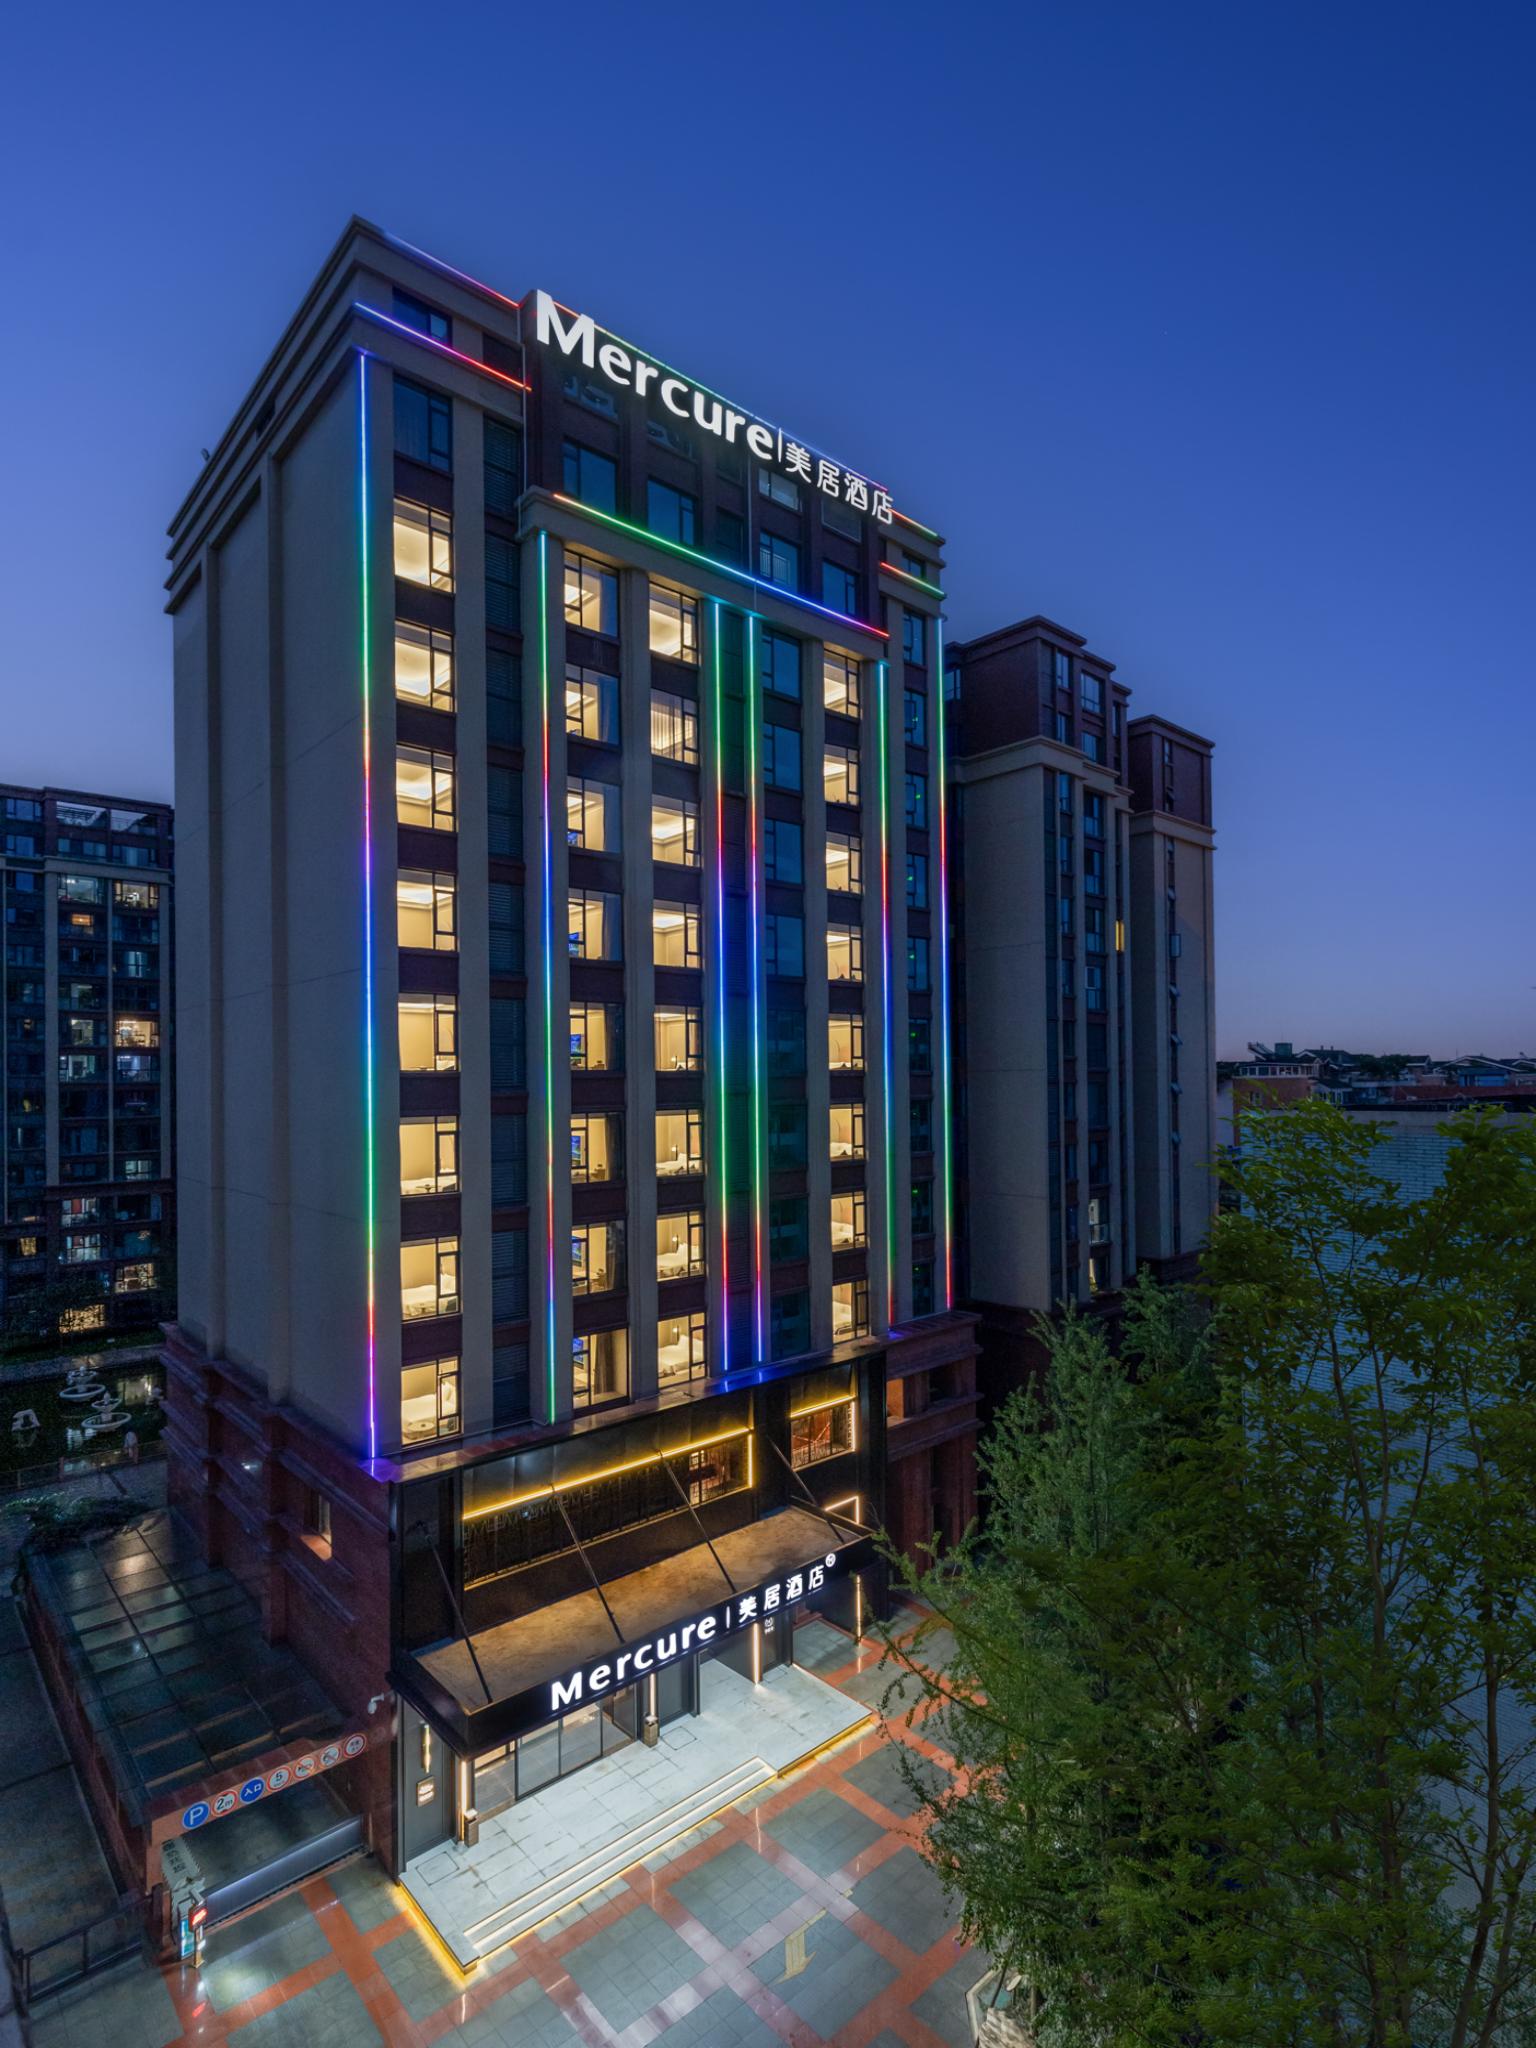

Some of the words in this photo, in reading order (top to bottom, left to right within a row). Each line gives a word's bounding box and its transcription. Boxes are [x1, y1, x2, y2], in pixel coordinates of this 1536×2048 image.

[536, 289, 773, 461] Mercure
[785, 441, 894, 525] 美居酒店
[551, 1615, 716, 1711] Mercure
[738, 1565, 824, 1623] 美居酒店
[275, 1771, 283, 1782] 5
[244, 1783, 262, 1797] 入口
[189, 1806, 204, 1826] P
